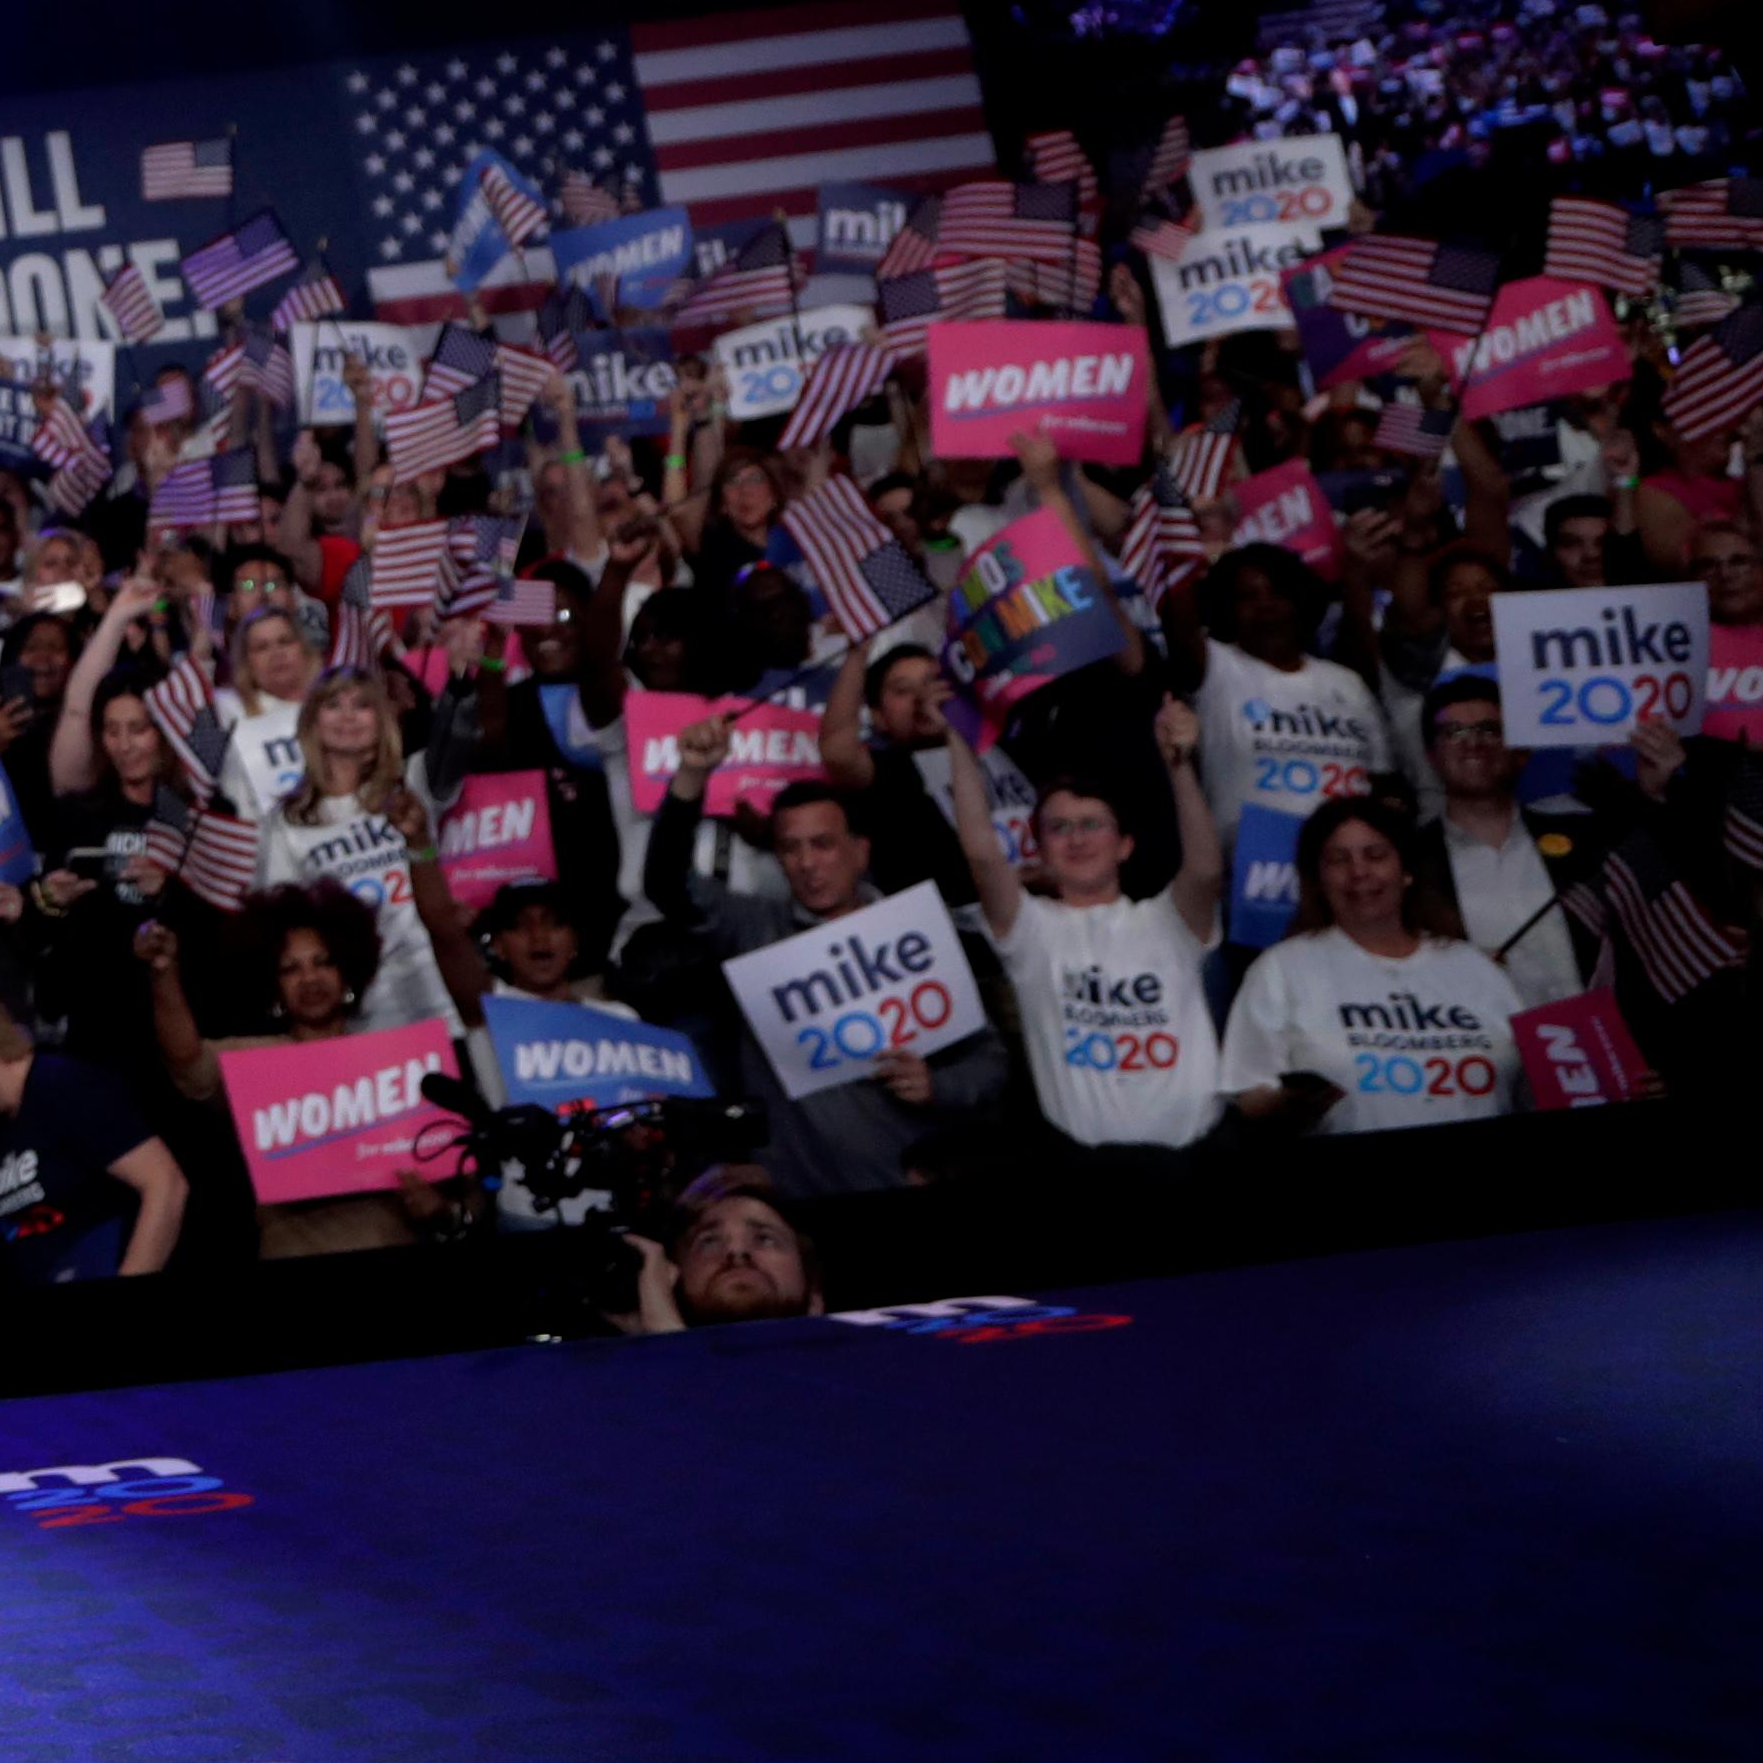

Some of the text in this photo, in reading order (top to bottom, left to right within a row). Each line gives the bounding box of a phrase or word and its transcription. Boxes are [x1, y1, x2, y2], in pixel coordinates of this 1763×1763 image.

[1212, 154, 1324, 195] mike
[1221, 186, 1332, 226] 2020
[1179, 237, 1301, 289] mike
[1451, 288, 1595, 380] WOMEN
[945, 352, 1134, 412] WOMEN
[1532, 604, 1692, 670] mike
[1537, 671, 1694, 725] 2020
[773, 931, 935, 1023] mike
[796, 980, 953, 1071] 2020
[1339, 993, 1482, 1031] mike
[514, 1038, 693, 1085] WOMEN
[1355, 1052, 1497, 1097] 2020
[253, 1051, 442, 1151] WOMEN
